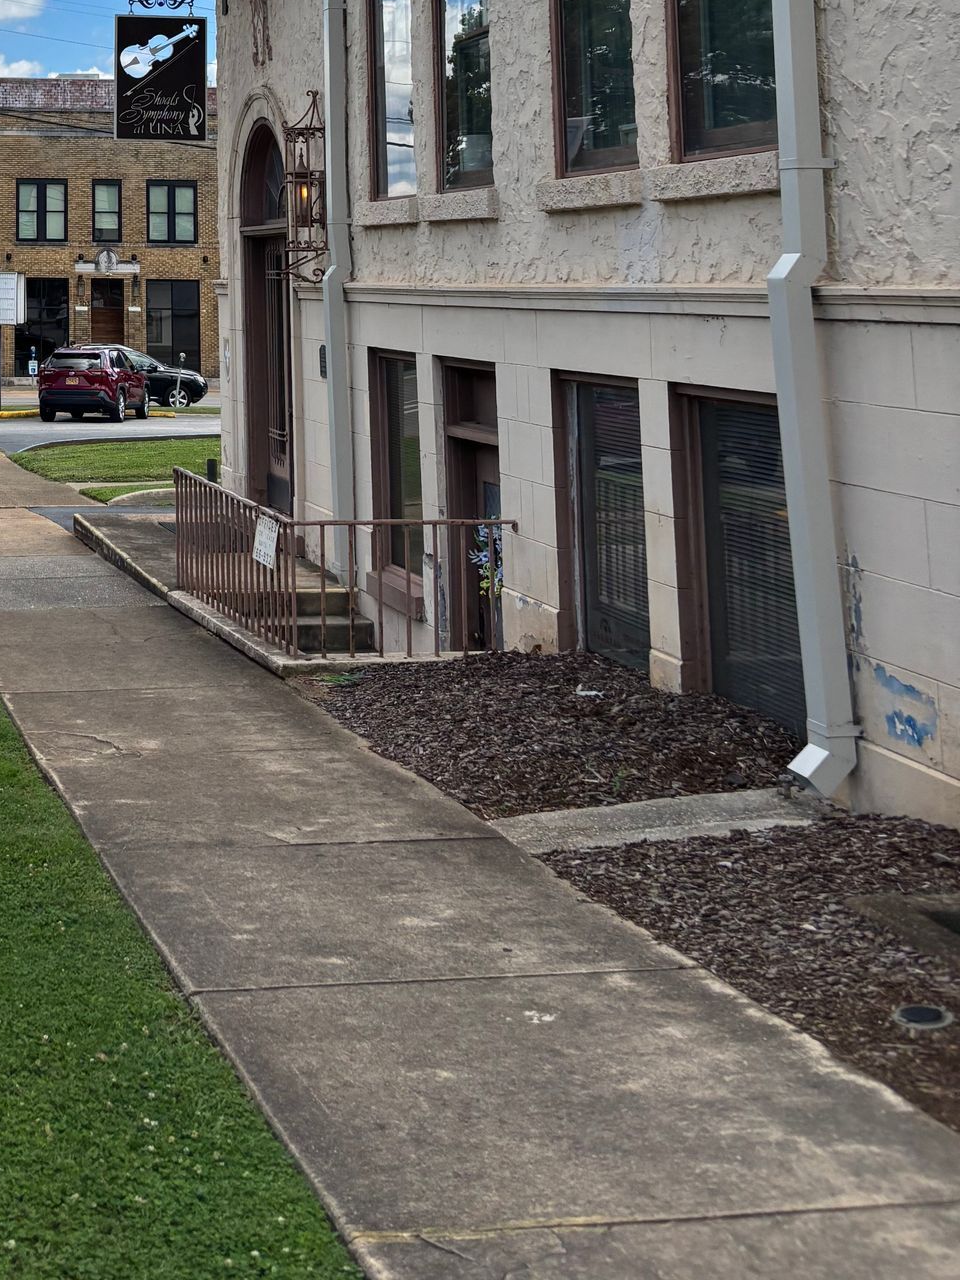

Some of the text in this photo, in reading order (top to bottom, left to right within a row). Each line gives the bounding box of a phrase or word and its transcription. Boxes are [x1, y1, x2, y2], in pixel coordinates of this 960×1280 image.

[132, 88, 179, 107] Shoals
[119, 103, 186, 126] Symphony
[149, 122, 184, 135] UNA
